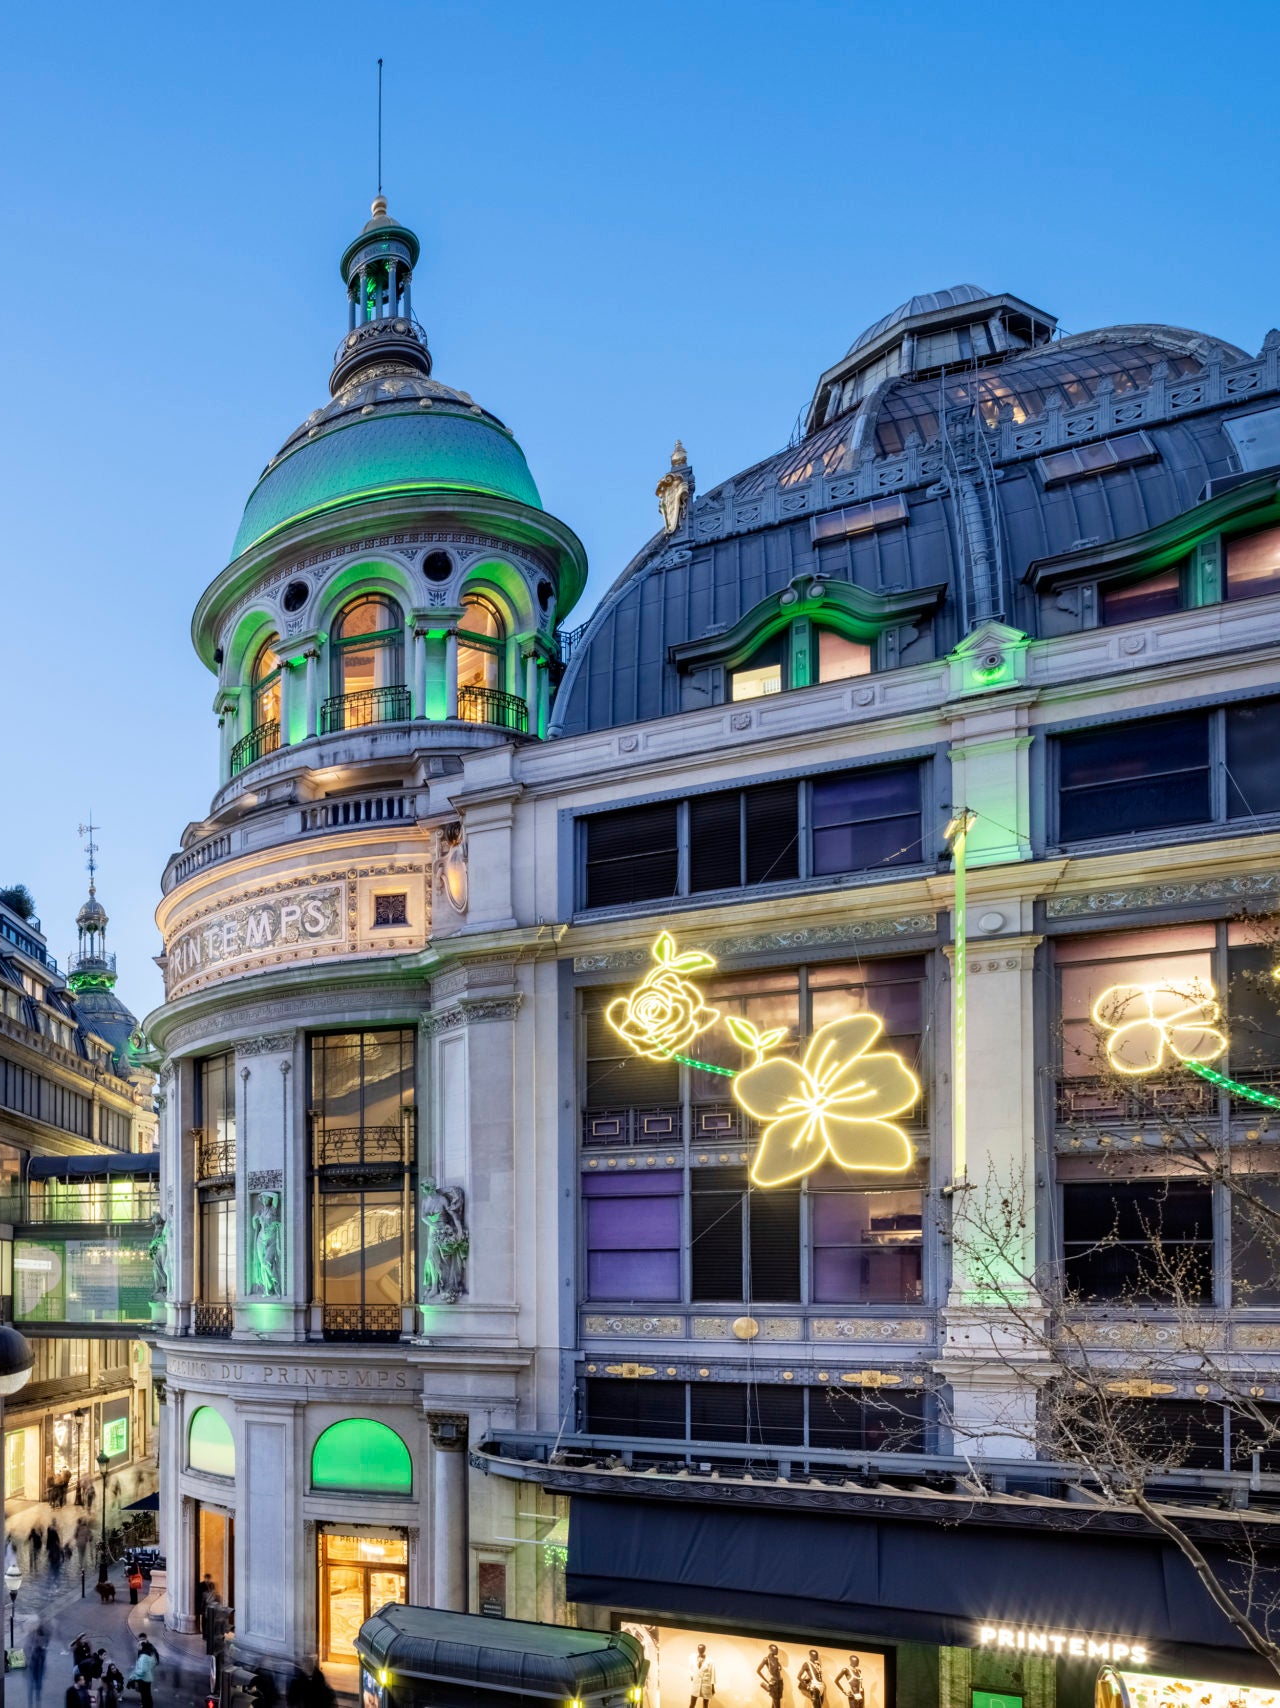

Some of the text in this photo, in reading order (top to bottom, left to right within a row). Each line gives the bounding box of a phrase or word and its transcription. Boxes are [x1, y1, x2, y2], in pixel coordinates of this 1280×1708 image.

[168, 900, 326, 980] PRINTEMPS
[221, 1364, 244, 1380] DU
[263, 1366, 407, 1388] PRINTEMPS
[980, 1627, 1148, 1663] PRINTEMPS
